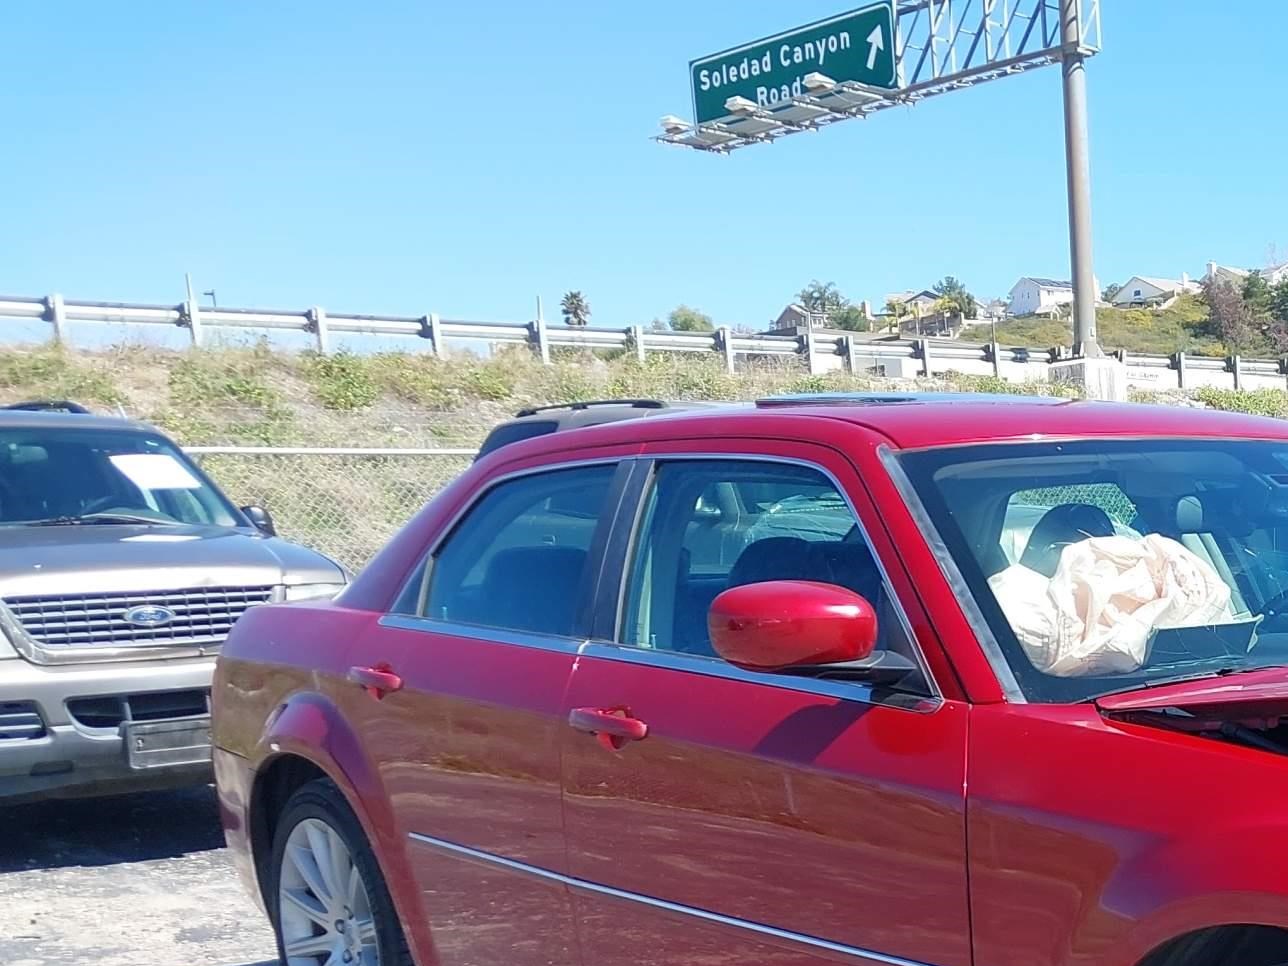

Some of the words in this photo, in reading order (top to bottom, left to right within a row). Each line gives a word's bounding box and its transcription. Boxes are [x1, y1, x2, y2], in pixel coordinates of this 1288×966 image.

[700, 50, 771, 90] Soledad
[780, 31, 850, 66] Canyon
[756, 77, 801, 107] Road
